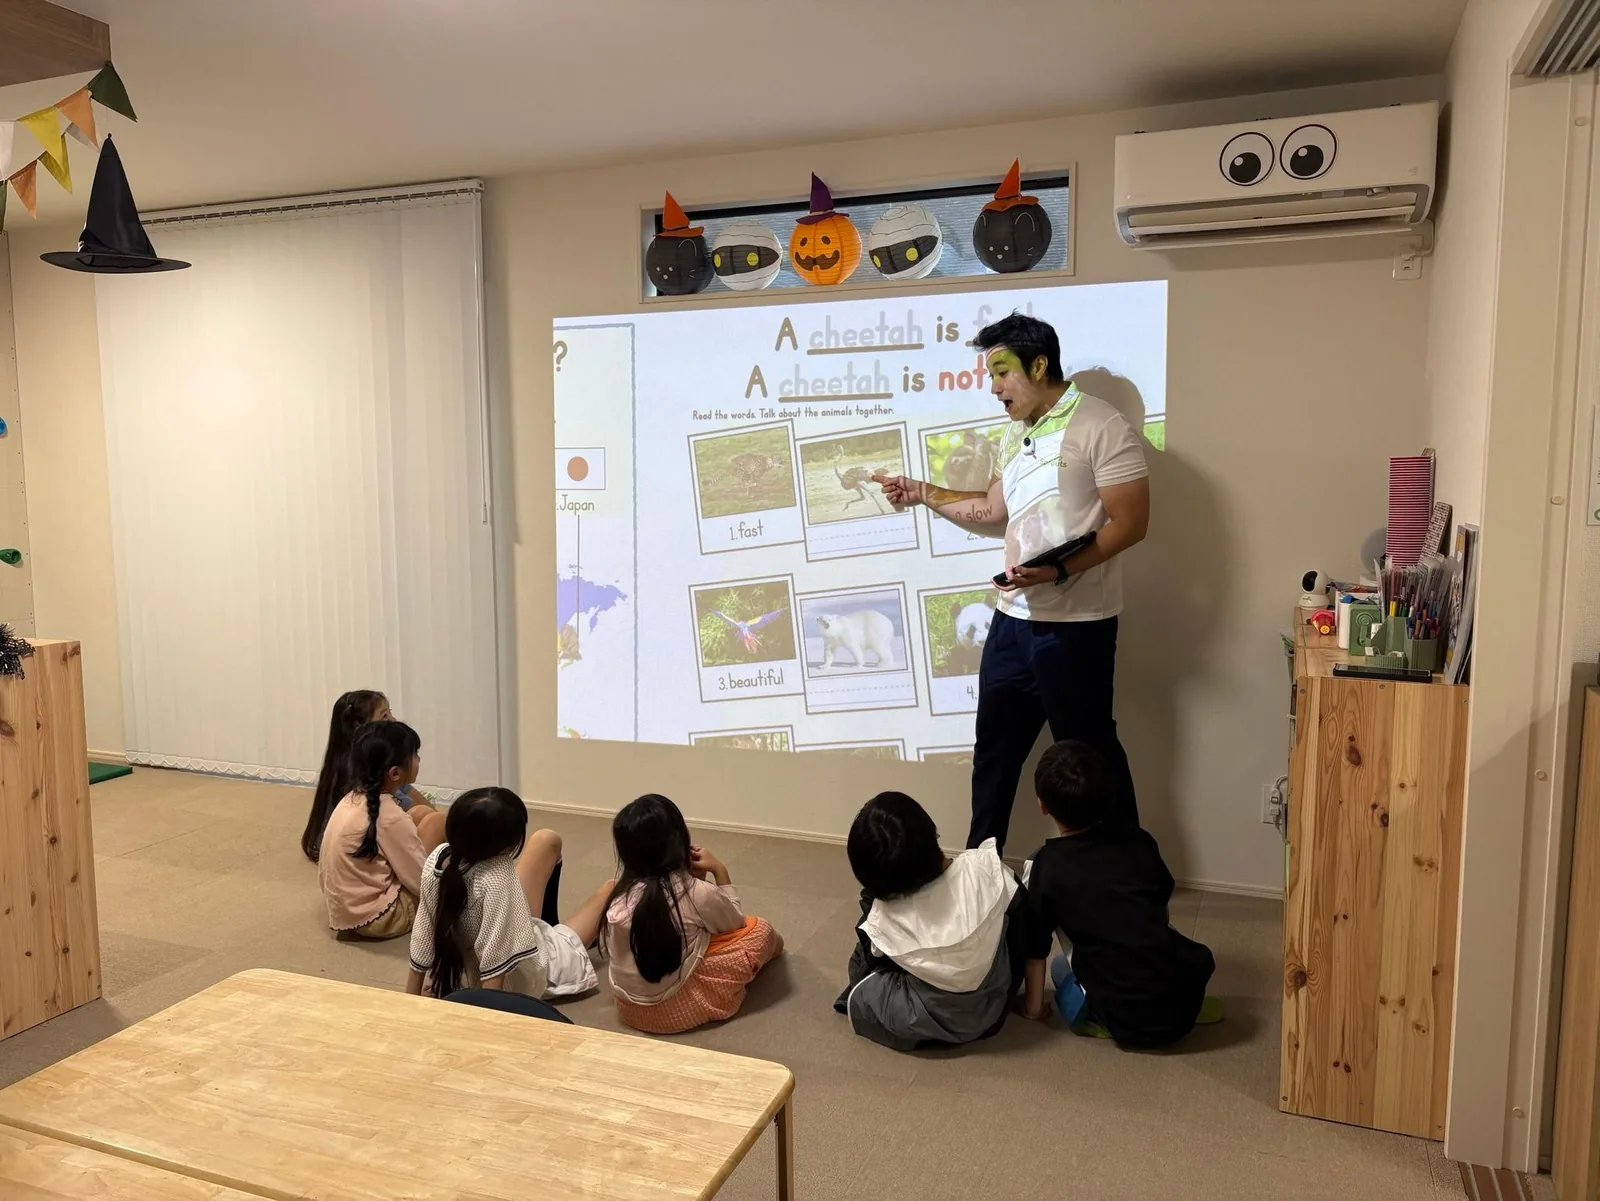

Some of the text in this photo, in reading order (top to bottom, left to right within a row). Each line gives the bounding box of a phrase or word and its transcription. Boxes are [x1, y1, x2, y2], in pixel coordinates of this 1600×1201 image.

[775, 316, 798, 351] A
[809, 309, 923, 348] cheetah
[936, 314, 960, 343] is
[745, 353, 988, 399] A cheetah is not
[692, 404, 895, 421] Read the words. Talk about the animals together.
